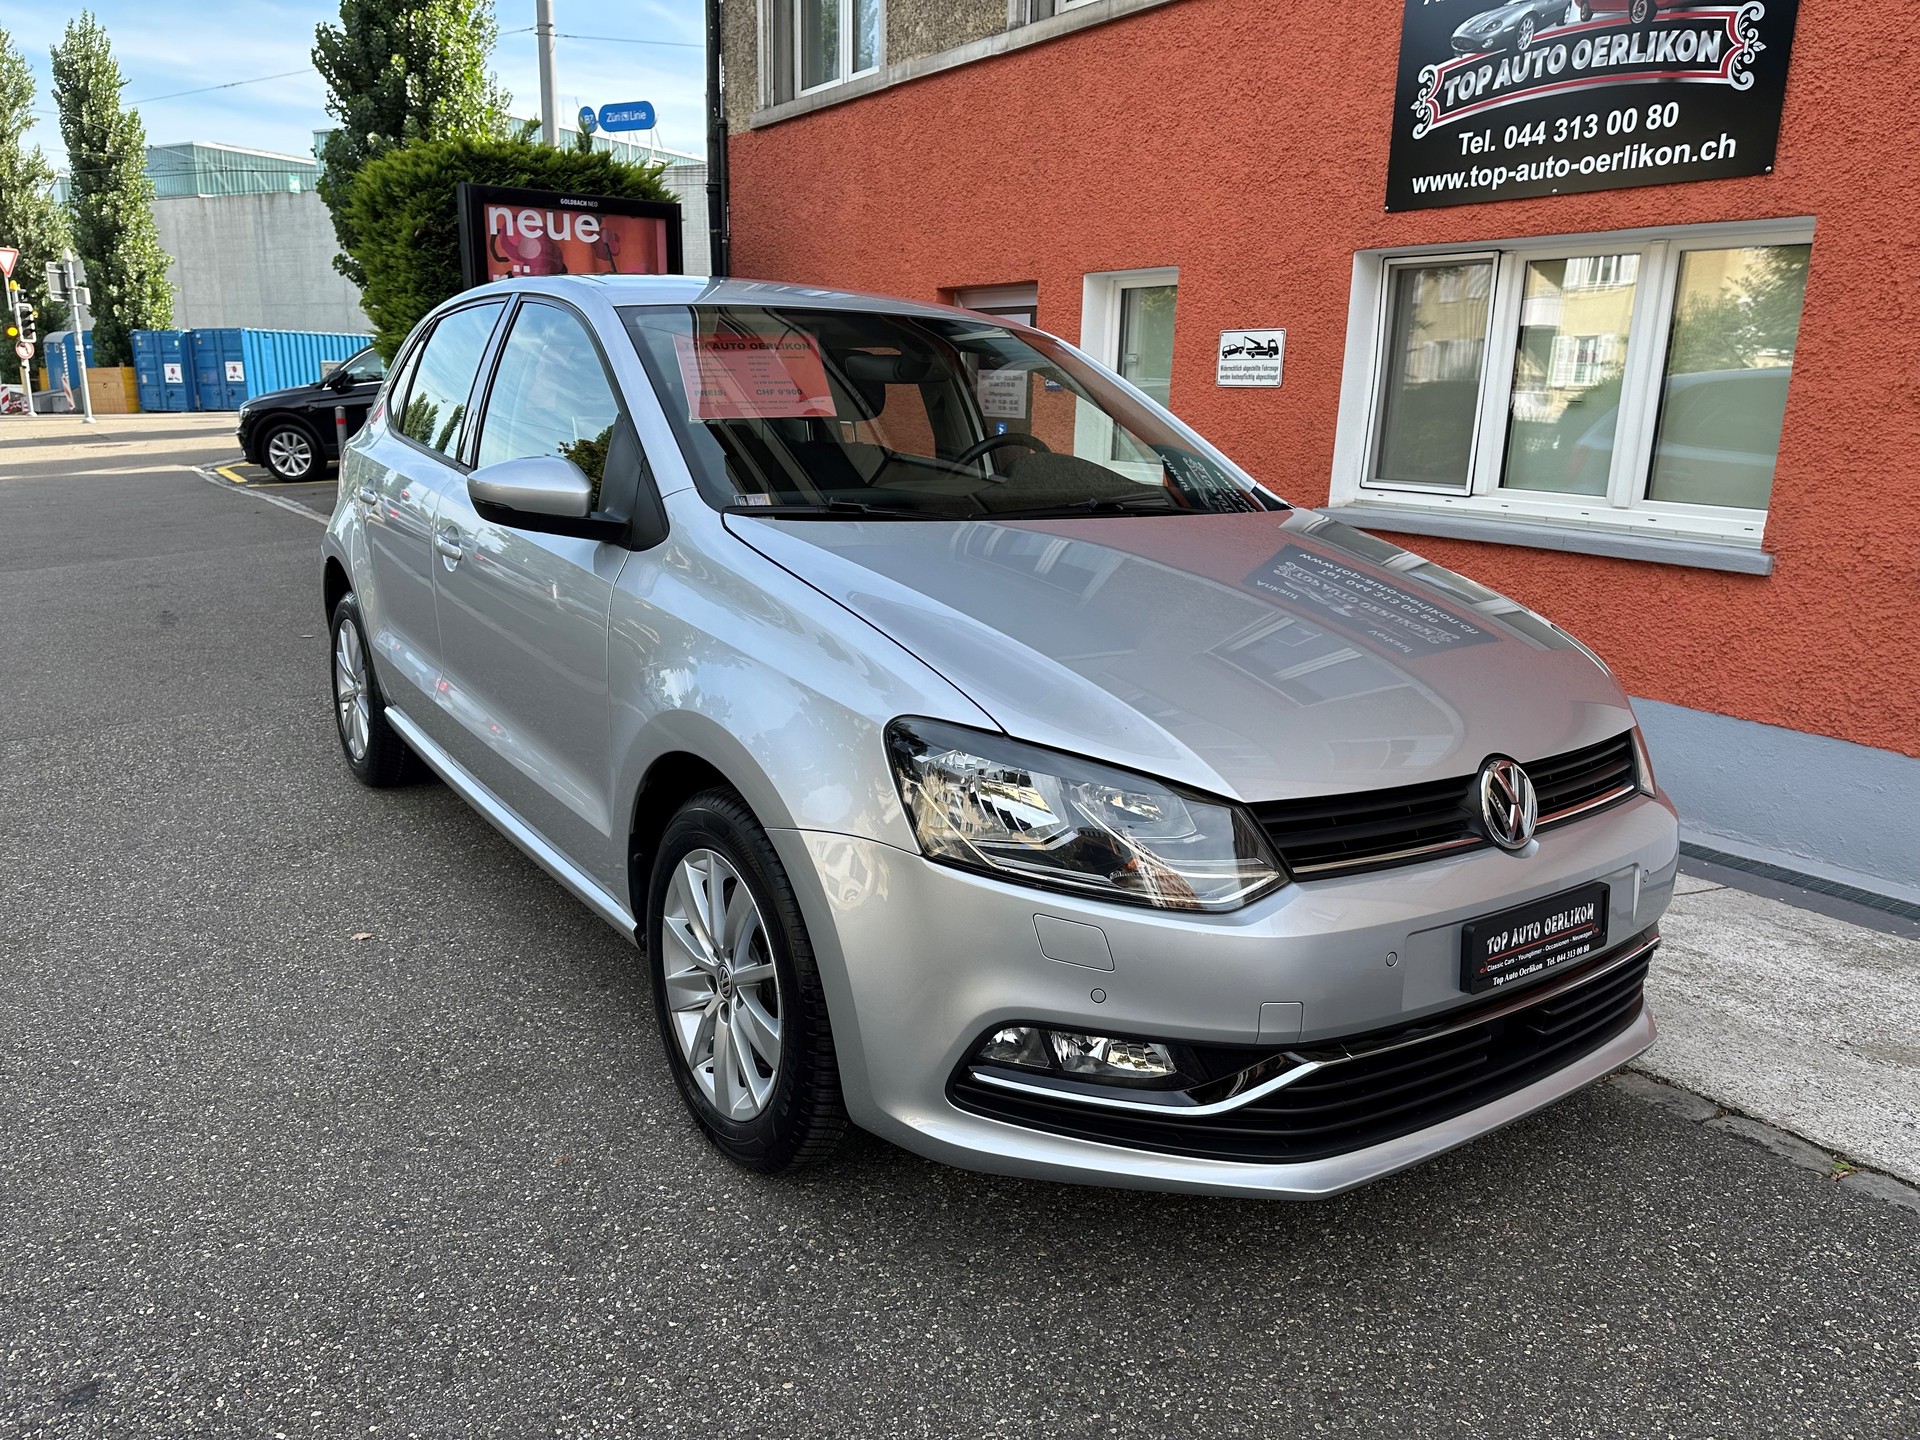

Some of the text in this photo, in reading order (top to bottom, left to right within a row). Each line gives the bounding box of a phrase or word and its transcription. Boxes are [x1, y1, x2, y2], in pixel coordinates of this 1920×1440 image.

[1444, 30, 1722, 107] TOP AUTO OERLIKON
[629, 110, 647, 121] Linie
[1459, 102, 1679, 155] Tel. 044 313 00 80
[1412, 133, 1736, 194] www.top-auto-oerlikon.ch
[488, 206, 600, 243] neue
[712, 342, 746, 351] AUTO
[749, 342, 811, 351] OERLIKON
[1487, 903, 1594, 955] TOP AUTO OERLIKON
[1487, 962, 1504, 972] Classic
[1504, 958, 1515, 966] Cars
[1518, 948, 1542, 961] Youngtimer
[1545, 939, 1569, 952] Occasionen
[1493, 944, 1590, 985] Top Auto Oerlikon Tel. 044 313 00 80
